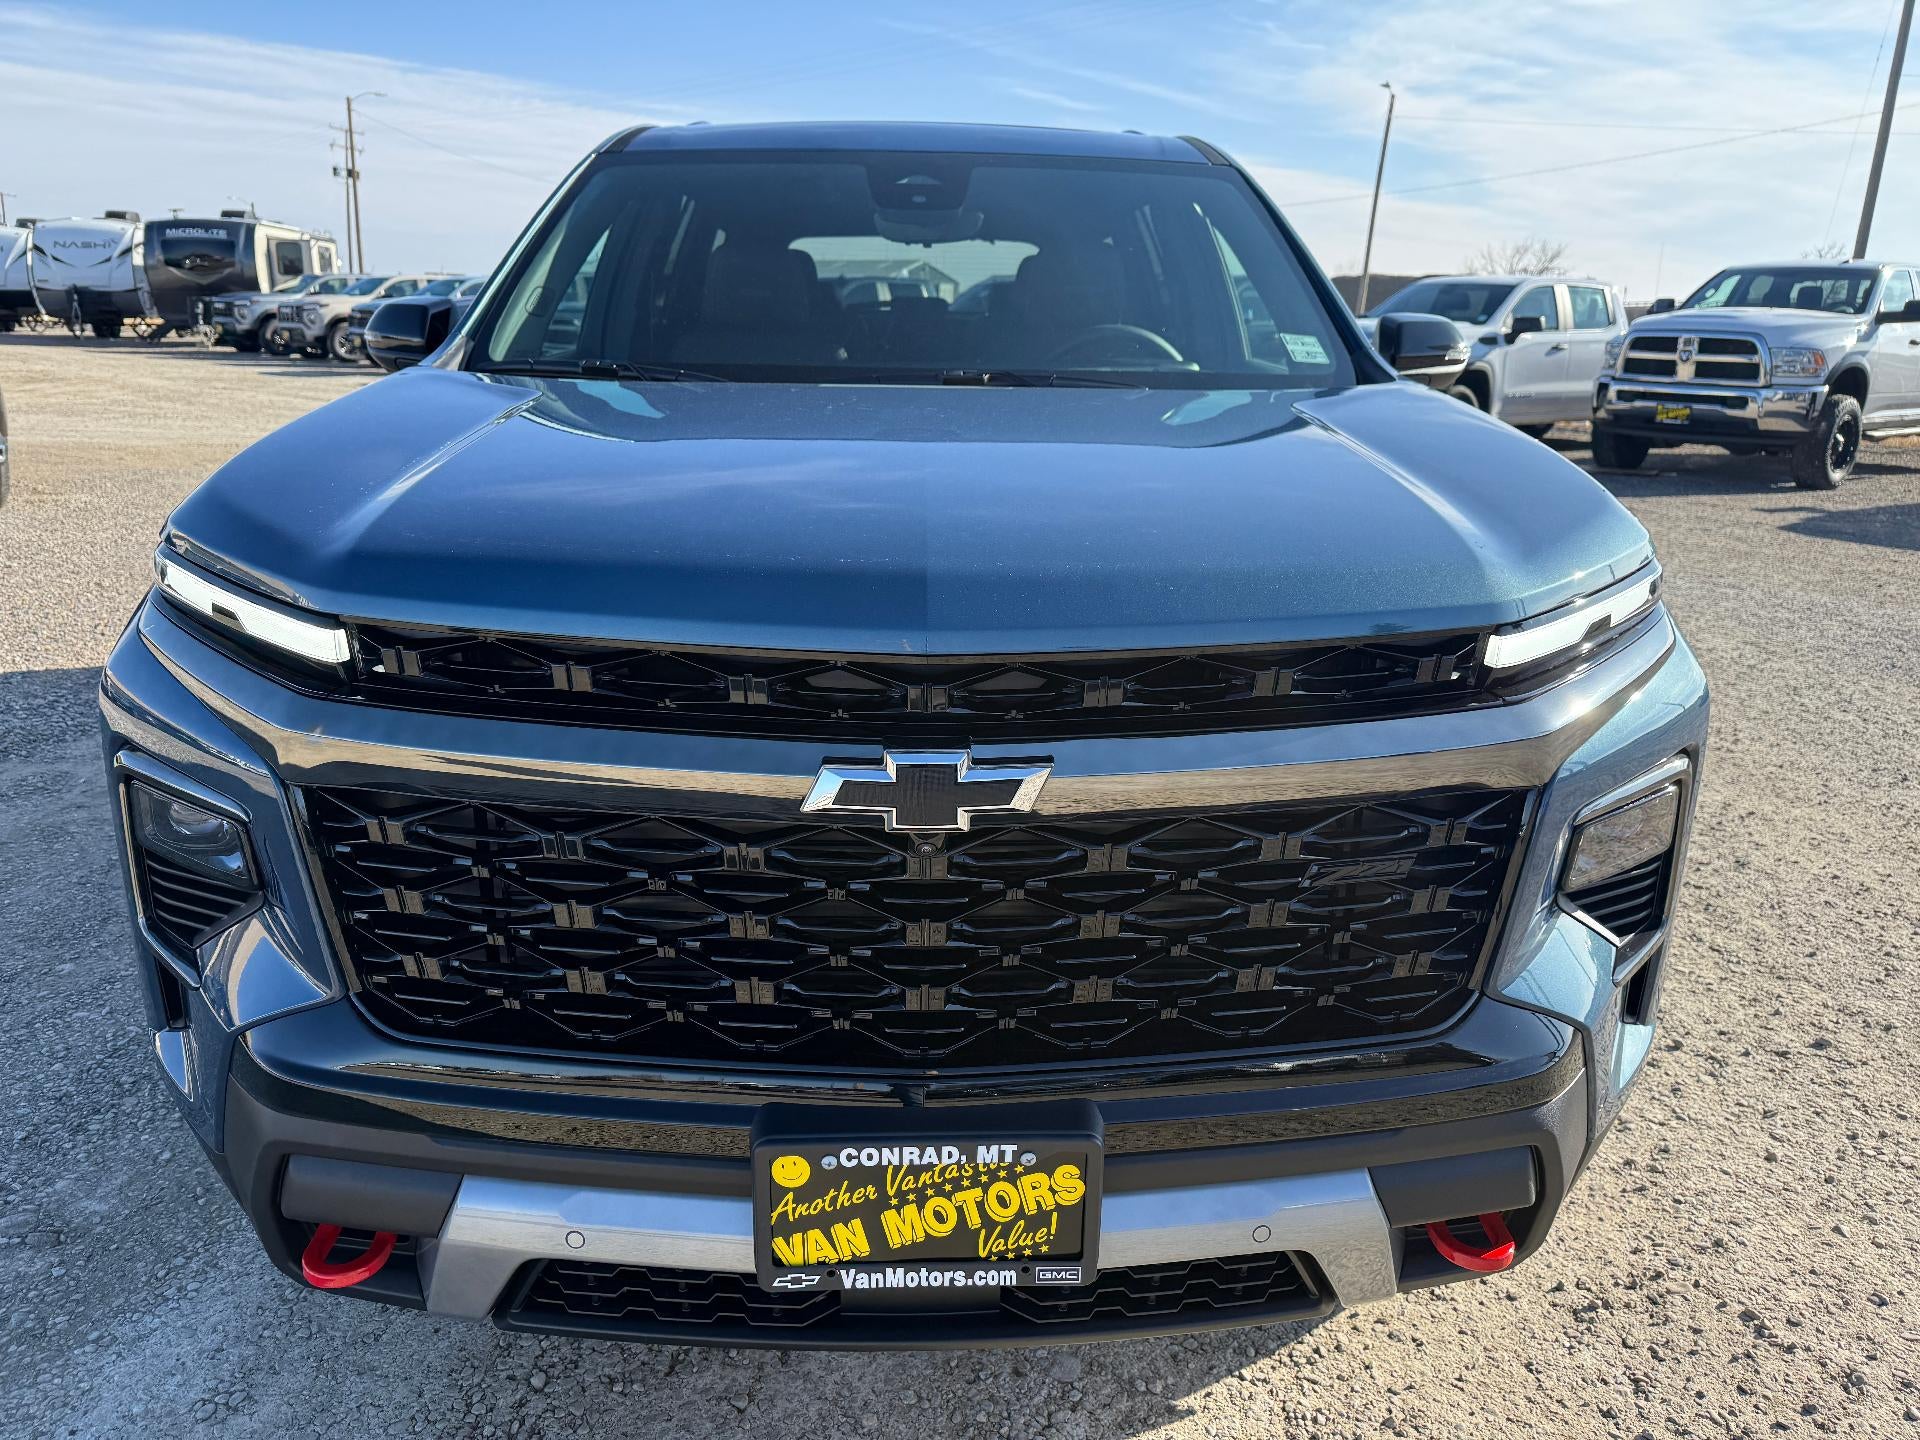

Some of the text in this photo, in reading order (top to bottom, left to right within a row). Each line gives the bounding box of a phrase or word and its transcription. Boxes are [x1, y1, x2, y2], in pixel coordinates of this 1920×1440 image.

[839, 1144, 1018, 1168] CONRAD, MT
[771, 1162, 1010, 1226] Another Vantas
[771, 1164, 1086, 1267] VAN MOTORS
[978, 1211, 1058, 1258] Value!
[839, 1267, 1017, 1289] VanMotors.com
[1039, 1271, 1078, 1279] GMC
